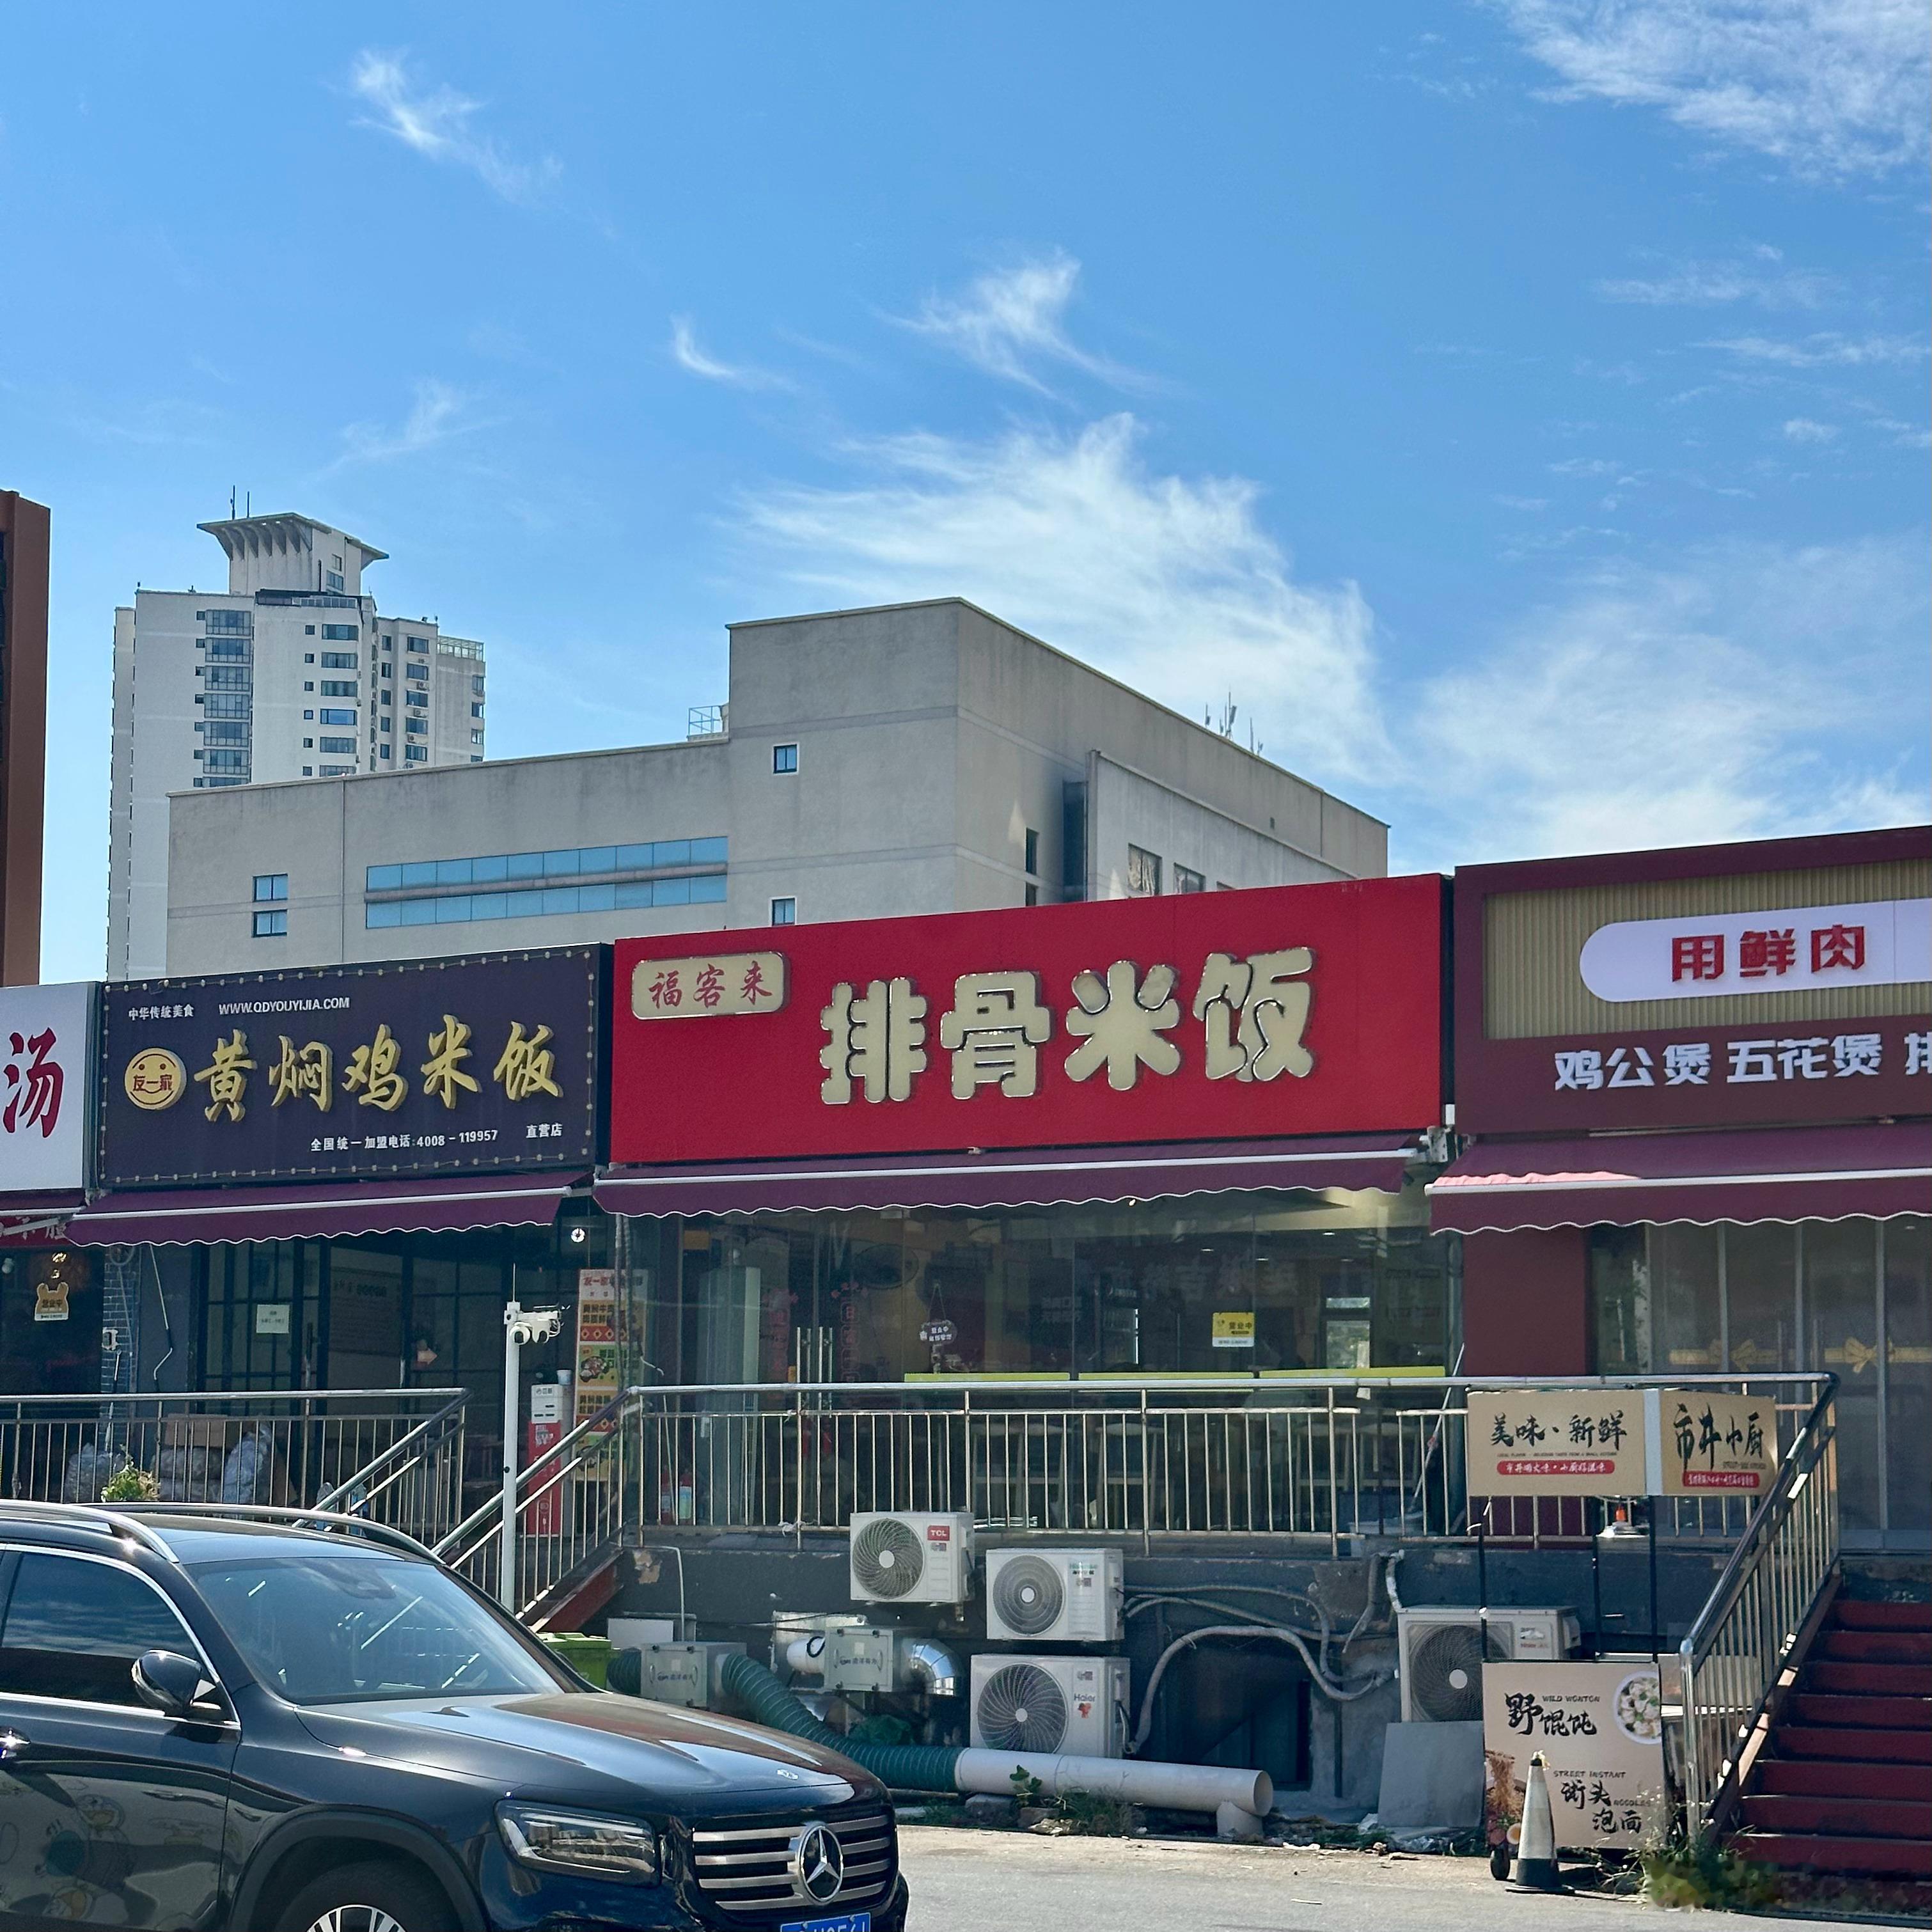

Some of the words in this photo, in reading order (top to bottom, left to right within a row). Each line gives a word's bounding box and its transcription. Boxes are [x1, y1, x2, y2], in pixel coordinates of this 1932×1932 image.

[1671, 923, 1865, 982] 用鲜肉
[648, 960, 773, 1009] 福客来
[129, 1005, 194, 1021] 中华传统美食
[219, 997, 350, 1016] WWW.QDYOUYIJIA.COM
[820, 946, 1315, 1106] 排骨米饭
[3, 1027, 64, 1138] 汤
[132, 1074, 173, 1091] 友一家
[194, 1014, 564, 1123] 黄焖鸡米饭
[1555, 1042, 1711, 1091] 鸡公煲
[1727, 1033, 1883, 1084] 五花煲
[526, 1122, 563, 1139] 直营店
[1505, 1693, 1597, 1736] 野馄饨
[1560, 1779, 1611, 1809] 街头
[1592, 1809, 1642, 1834] 泡面
